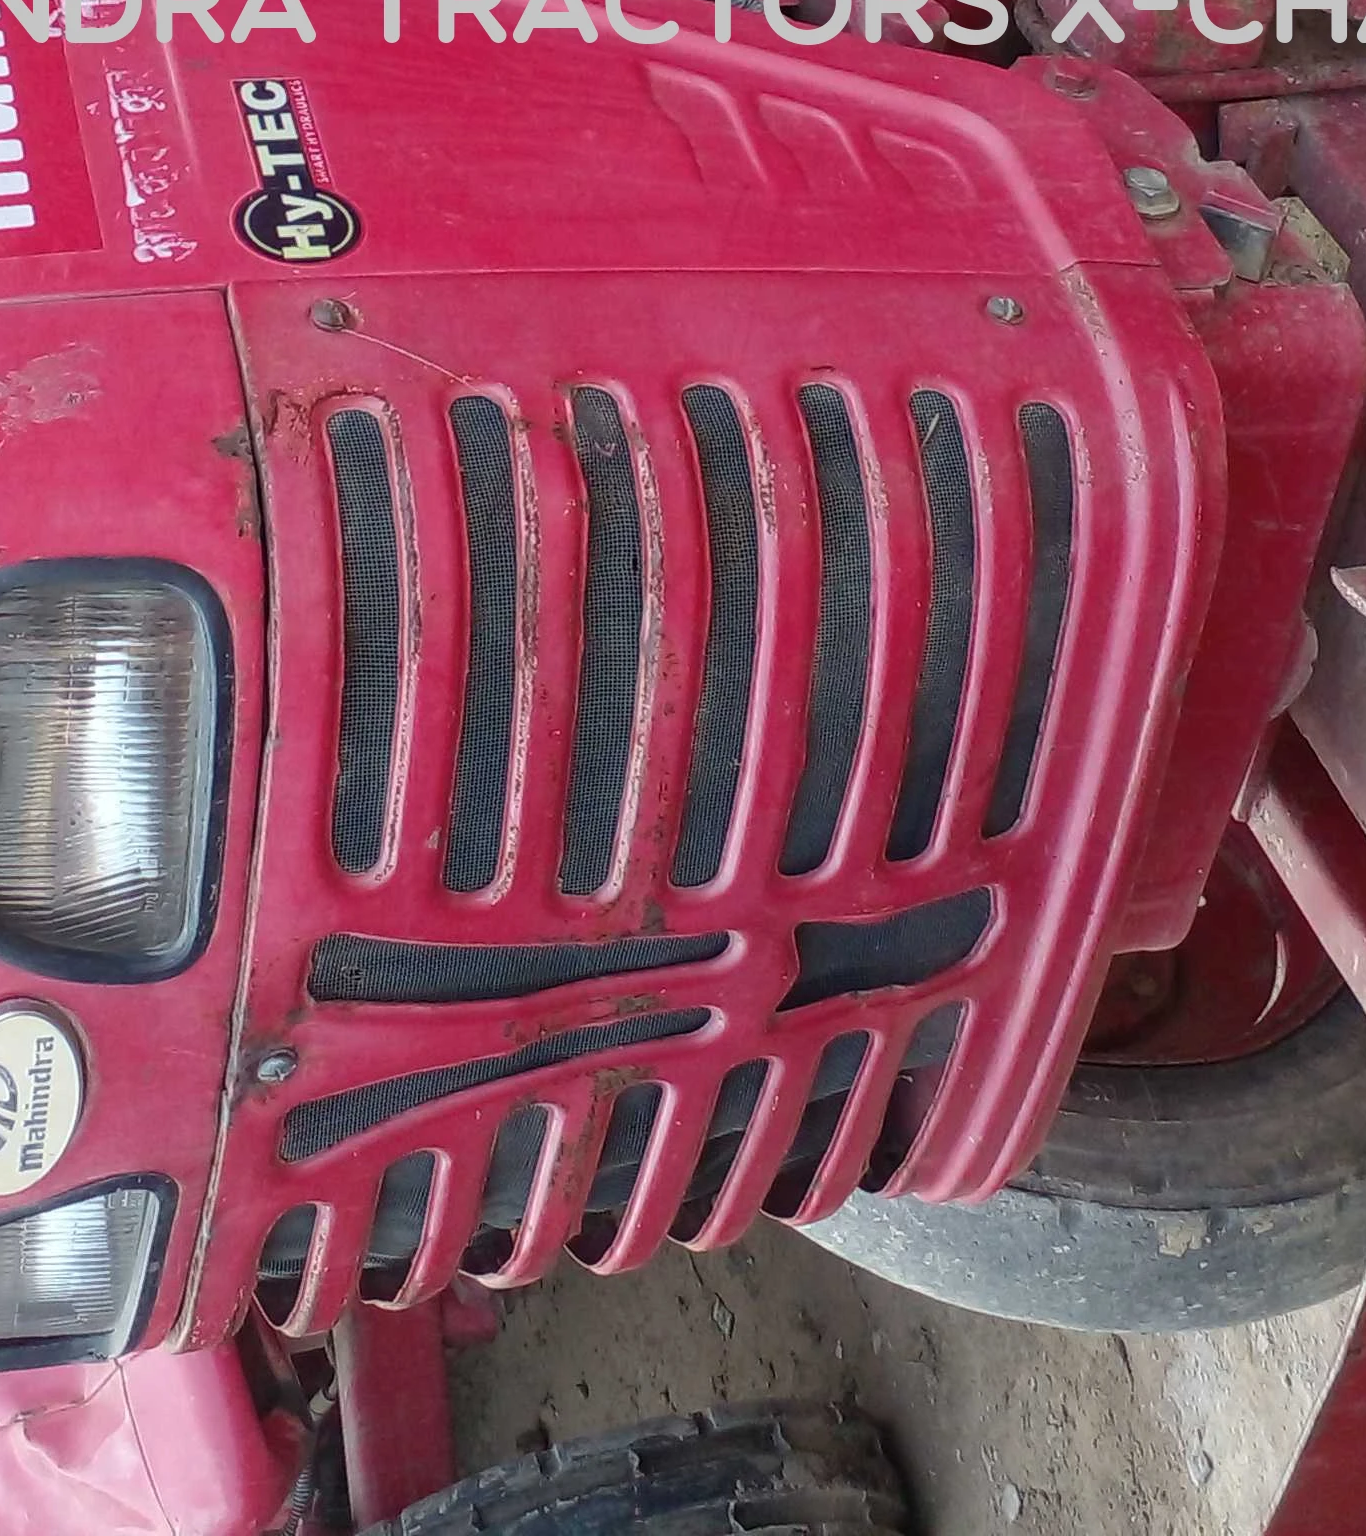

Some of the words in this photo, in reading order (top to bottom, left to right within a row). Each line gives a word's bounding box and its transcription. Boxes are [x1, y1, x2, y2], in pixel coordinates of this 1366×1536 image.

[289, 78, 320, 144] HYDRAULICS
[240, 78, 334, 258] Hy-TEC
[306, 145, 330, 183] SMART
[18, 1034, 55, 1172] Mahindra
